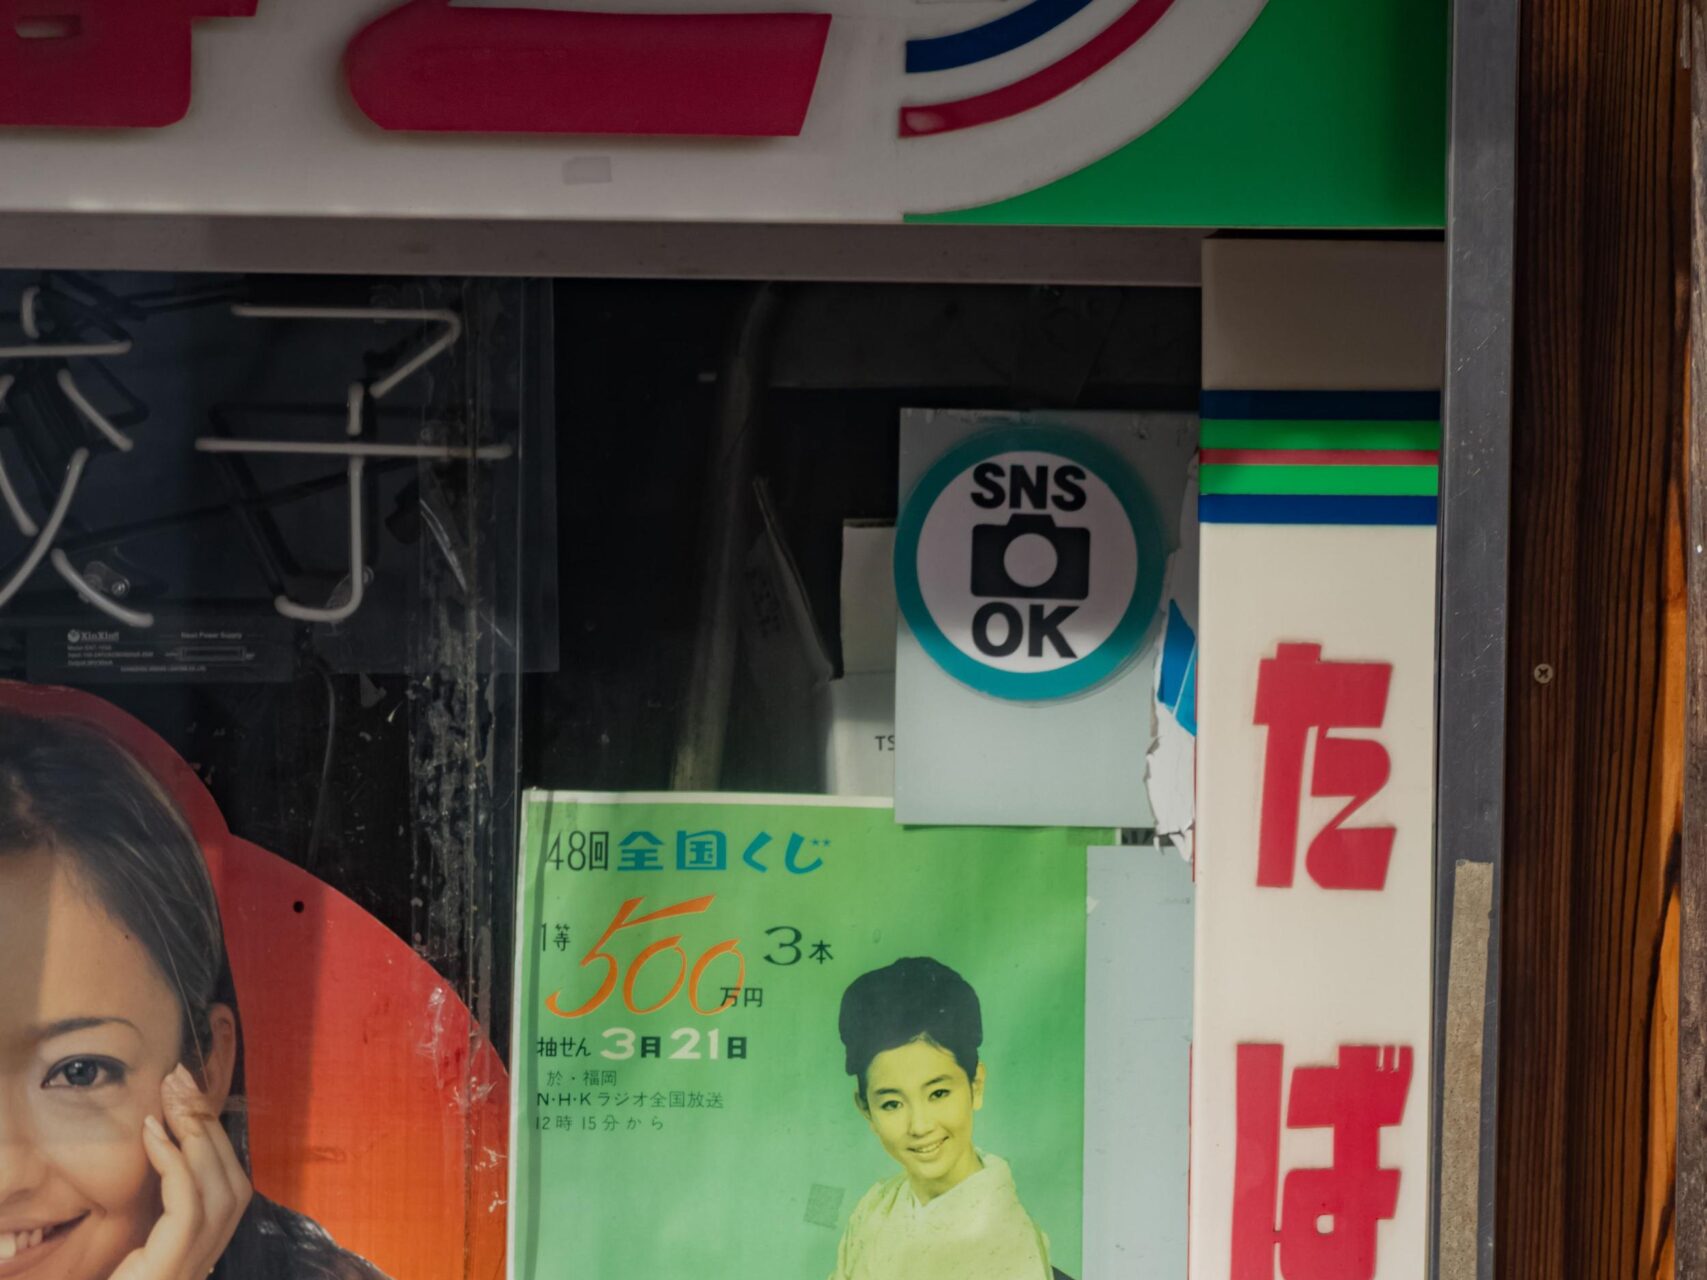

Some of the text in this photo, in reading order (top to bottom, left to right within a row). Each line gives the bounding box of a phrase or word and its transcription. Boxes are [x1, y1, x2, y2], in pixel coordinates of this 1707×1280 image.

[971, 462, 1088, 512] SNS
[971, 601, 1081, 659] OK
[541, 923, 571, 952] 1等
[763, 925, 834, 966] 3本
